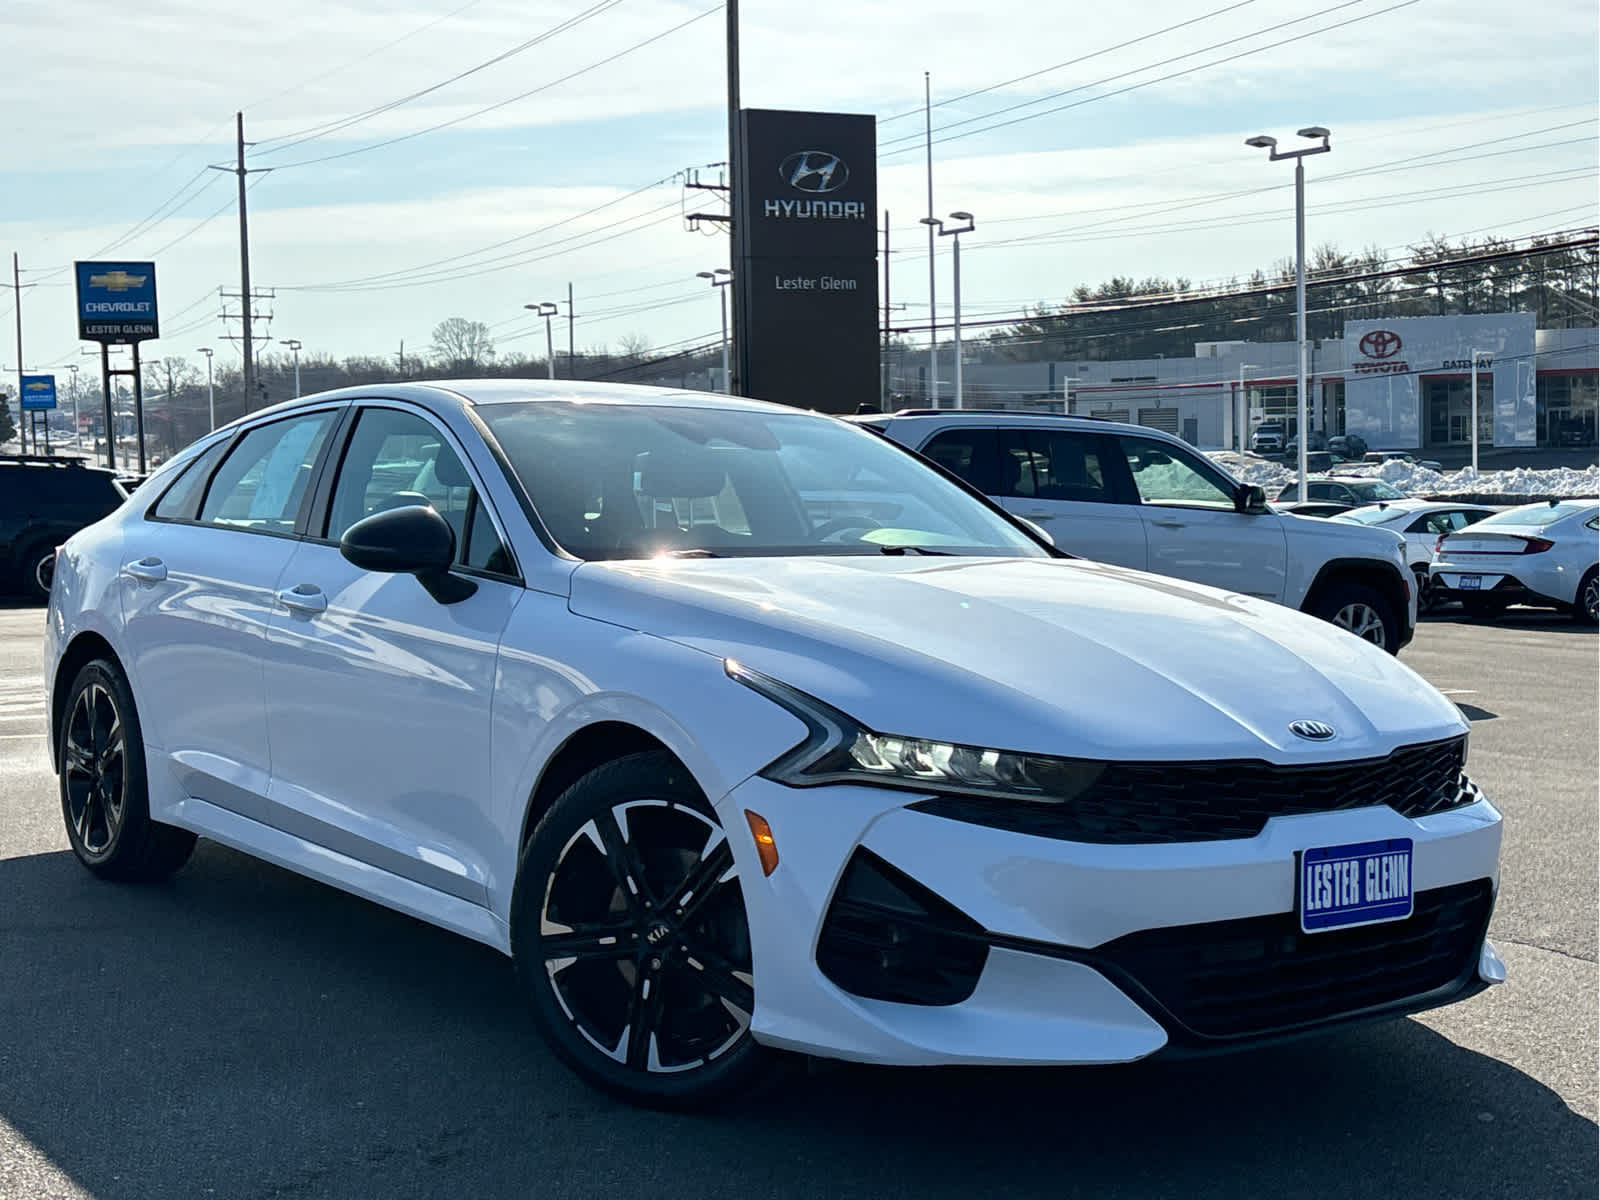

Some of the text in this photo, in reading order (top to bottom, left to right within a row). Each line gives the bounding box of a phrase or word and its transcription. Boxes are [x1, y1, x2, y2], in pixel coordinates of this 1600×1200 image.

[764, 199, 865, 219] HYUNDAI
[775, 275, 857, 290] Lester Glenn
[85, 302, 151, 313] CHEVROLET
[86, 324, 153, 334] LESTER GLENN
[1352, 361, 1409, 375] TOYOTA
[1294, 720, 1334, 735] KIA
[1306, 853, 1409, 911] LESTER GLENN
[647, 925, 670, 945] KIA
